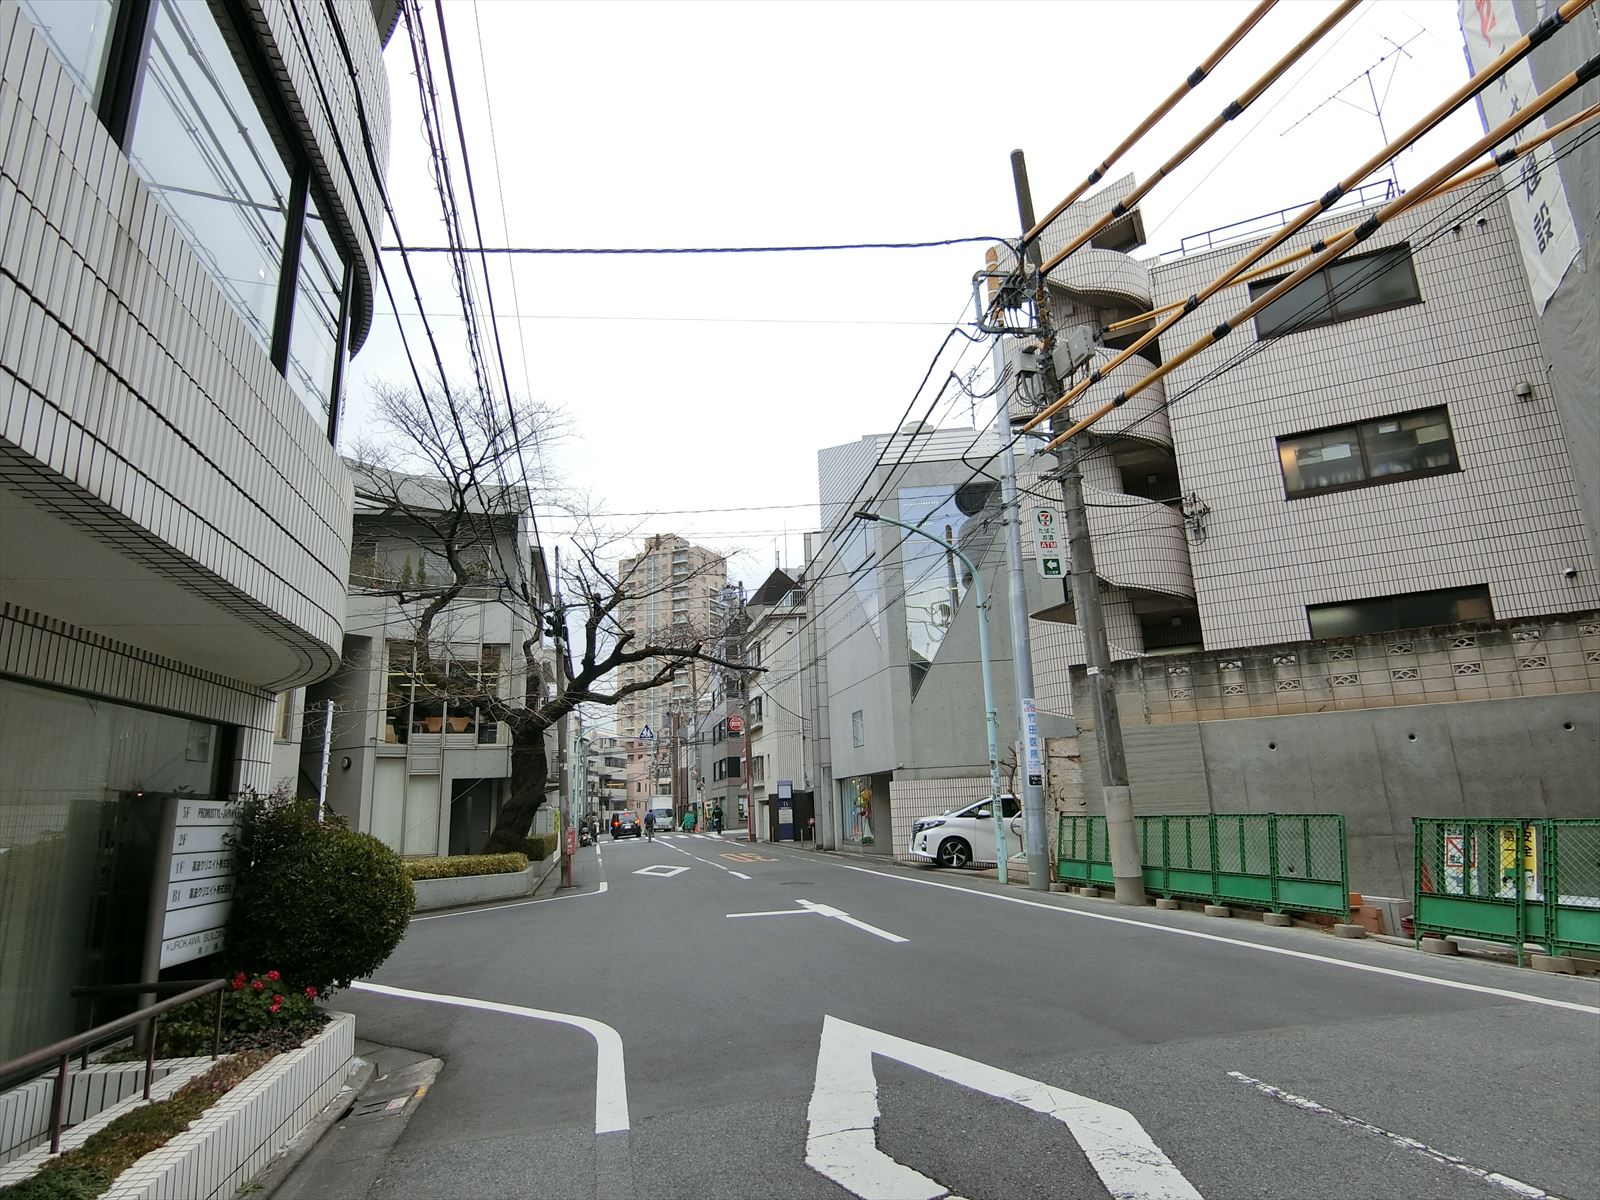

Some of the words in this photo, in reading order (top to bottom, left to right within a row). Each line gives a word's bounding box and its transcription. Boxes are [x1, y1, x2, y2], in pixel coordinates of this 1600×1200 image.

[1027, 713, 1039, 760] 竹田医院
[178, 833, 188, 846] 2F
[176, 861, 185, 874] 1F
[172, 890, 181, 902] B1
[166, 936, 200, 951] KUROKAWA
